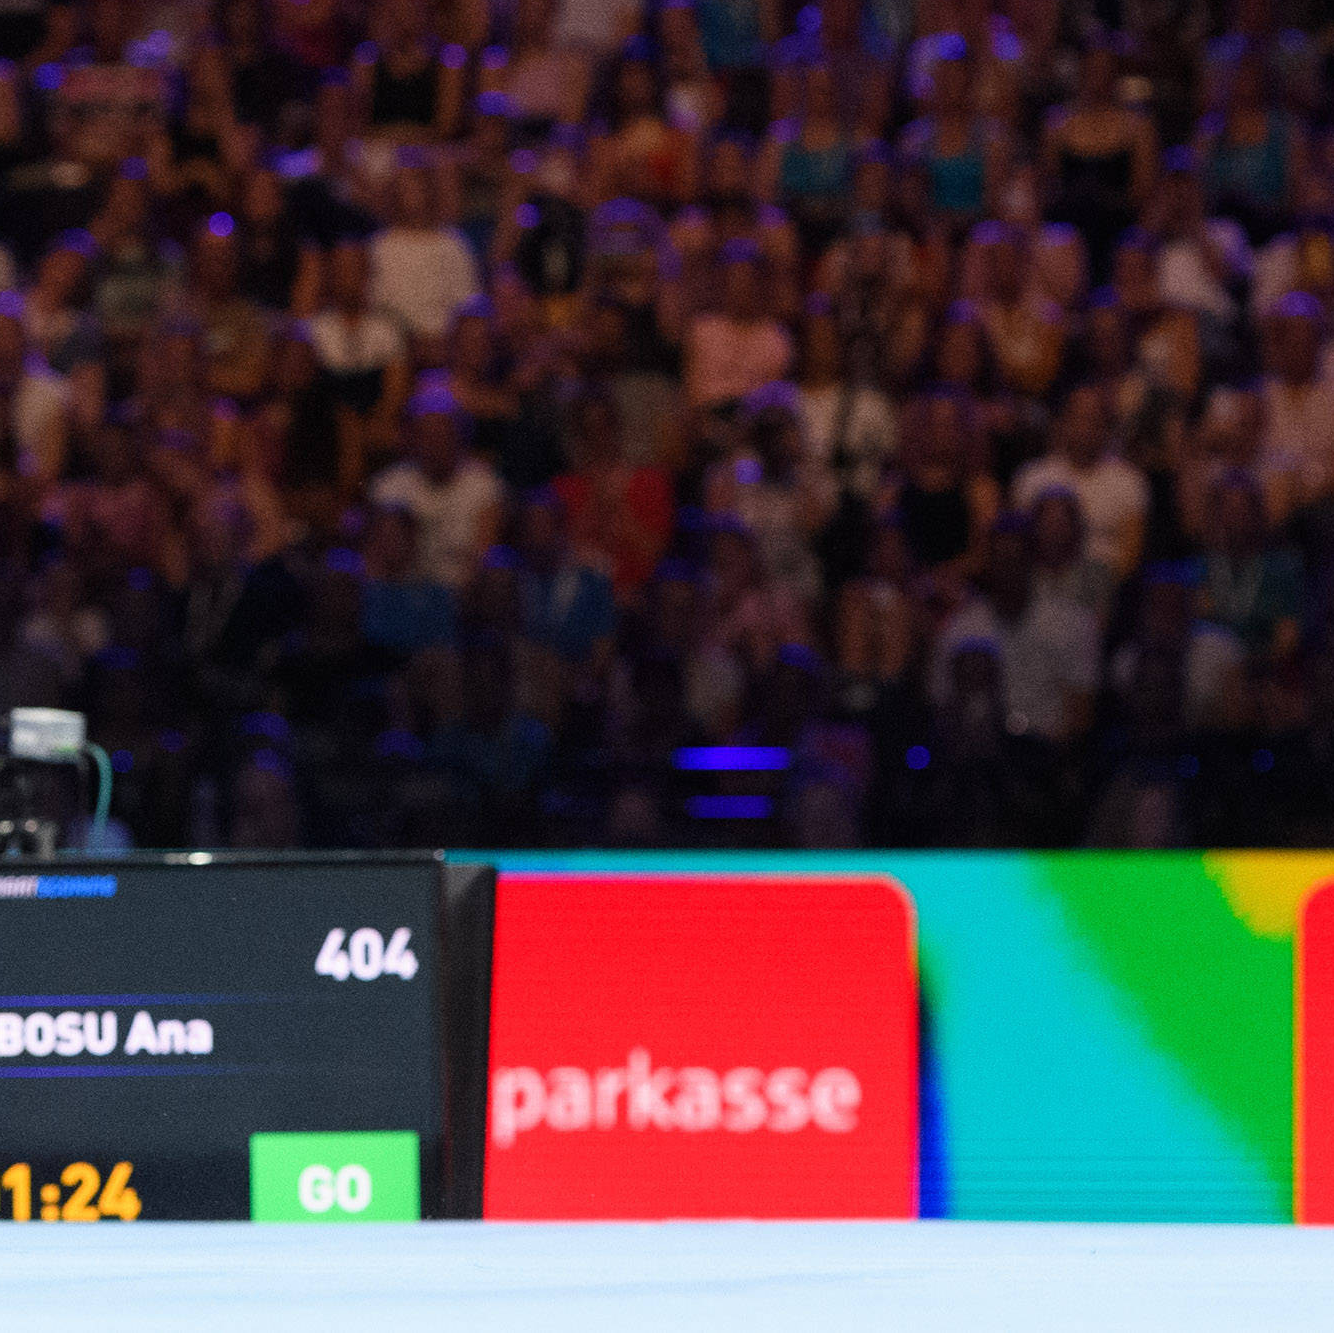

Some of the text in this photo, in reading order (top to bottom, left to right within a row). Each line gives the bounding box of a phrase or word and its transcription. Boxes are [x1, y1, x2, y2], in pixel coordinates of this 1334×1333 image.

[314, 927, 419, 982] 404
[123, 1011, 214, 1056] Ana
[298, 1164, 372, 1213] GO
